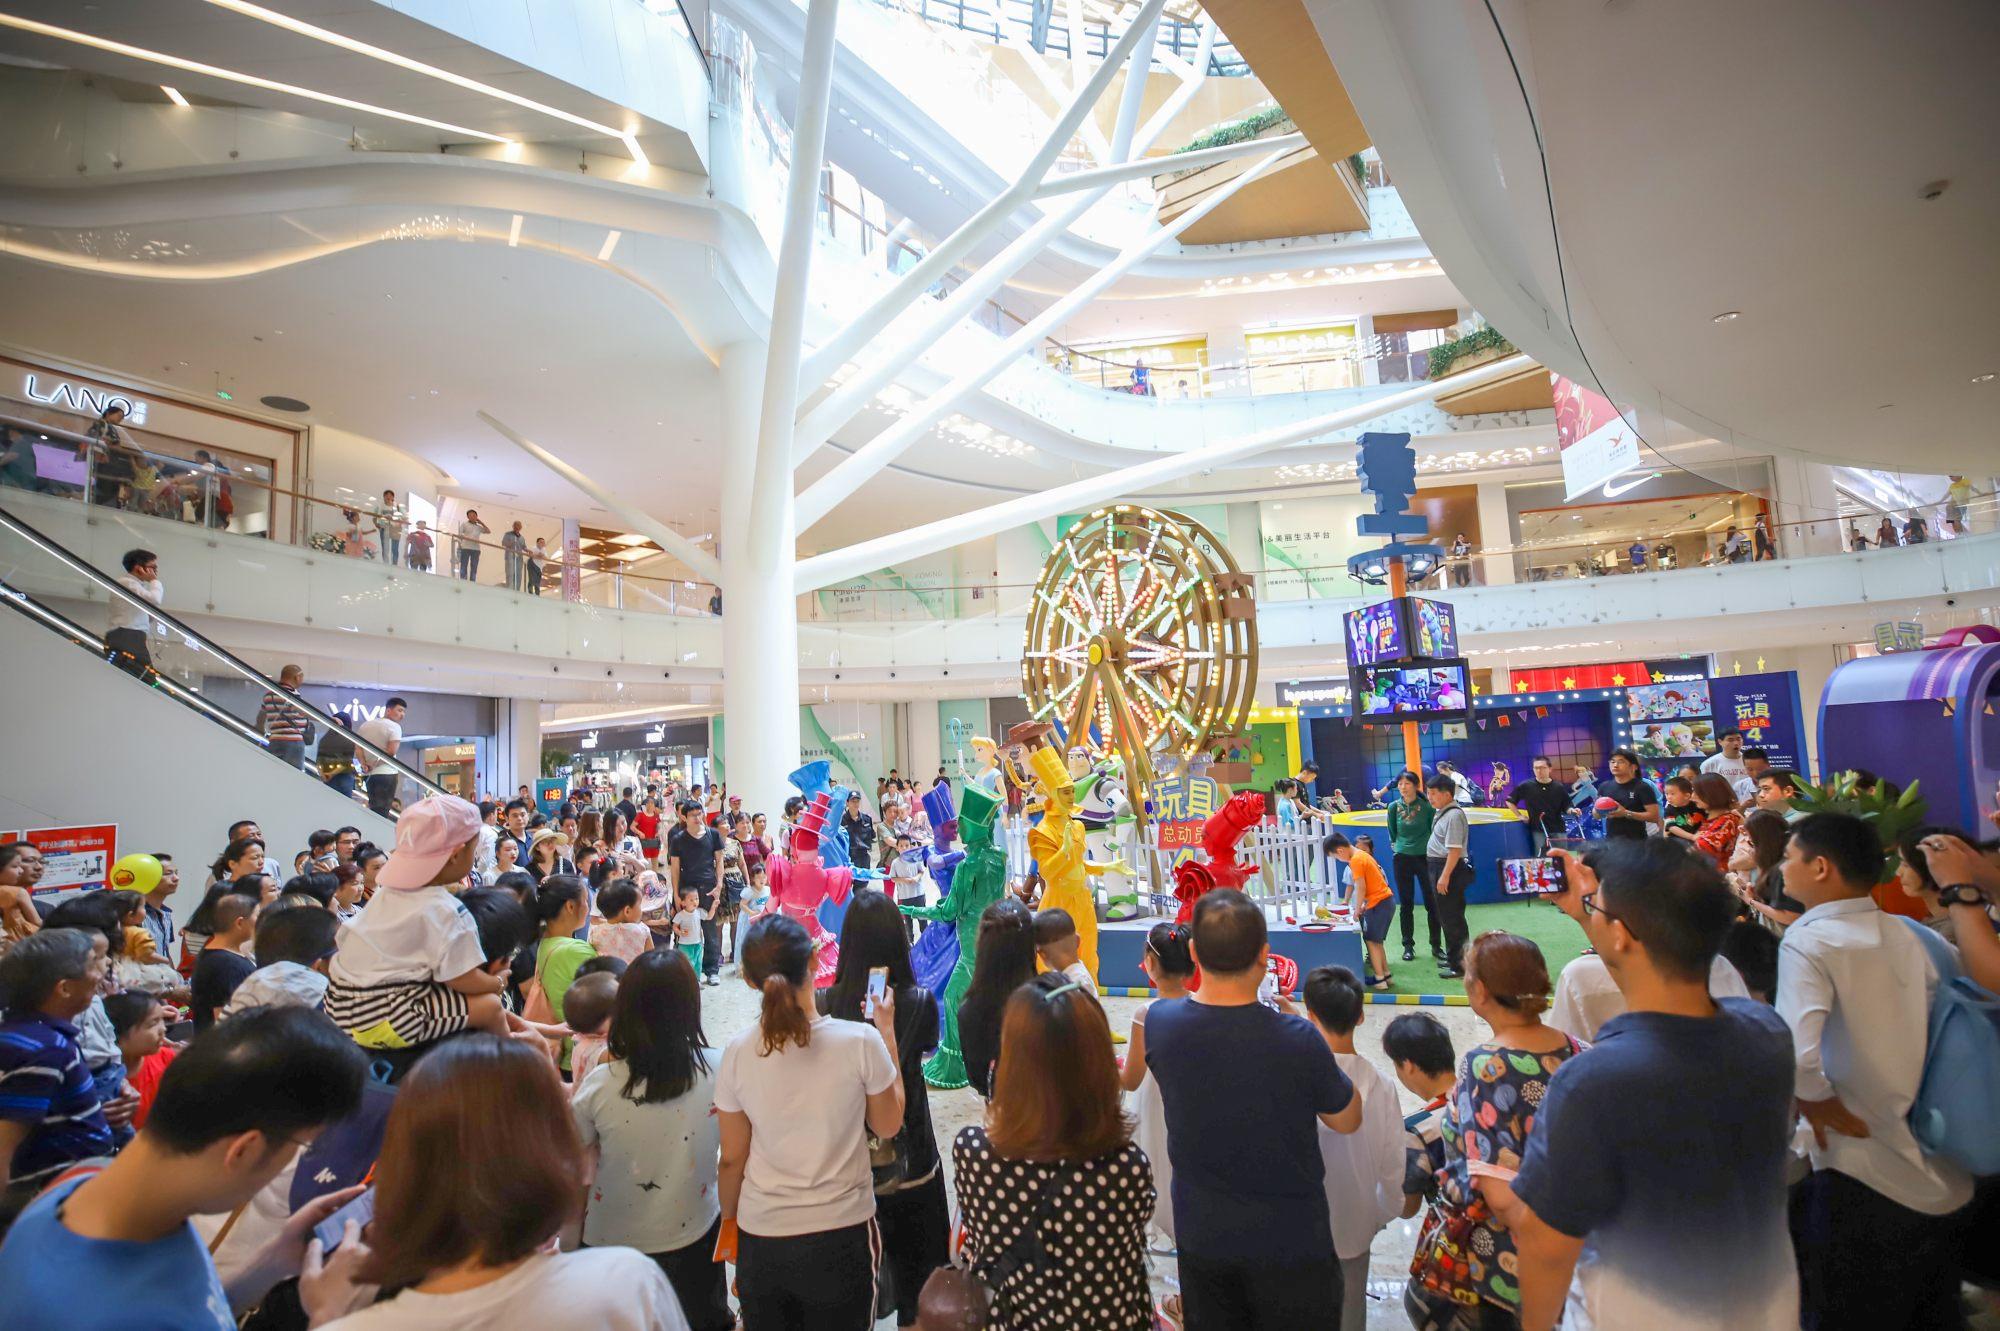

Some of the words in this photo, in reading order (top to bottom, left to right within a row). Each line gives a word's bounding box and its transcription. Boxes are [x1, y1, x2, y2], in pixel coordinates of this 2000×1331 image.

[1735, 703, 1770, 719] 玩具
[1747, 727, 1762, 742] 4
[1153, 779, 1214, 821] 玩具
